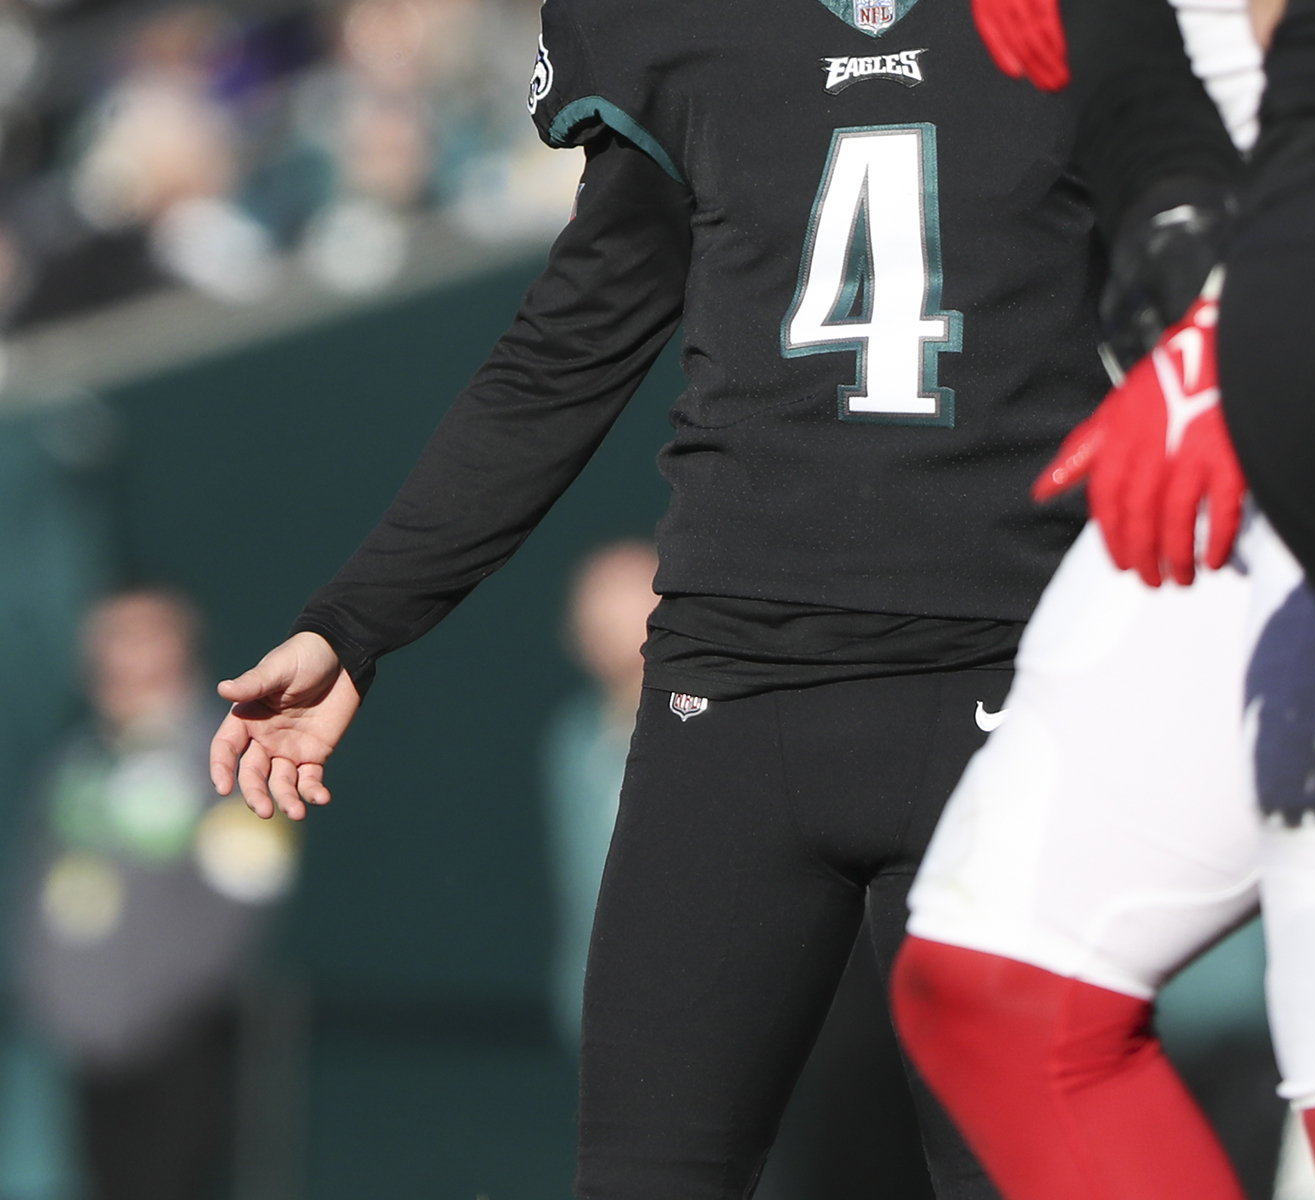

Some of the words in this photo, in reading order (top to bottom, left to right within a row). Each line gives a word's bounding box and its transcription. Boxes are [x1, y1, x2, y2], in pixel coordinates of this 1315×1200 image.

[859, 5, 890, 24] NFL
[820, 48, 928, 90] EAGLES
[780, 121, 963, 428] 4
